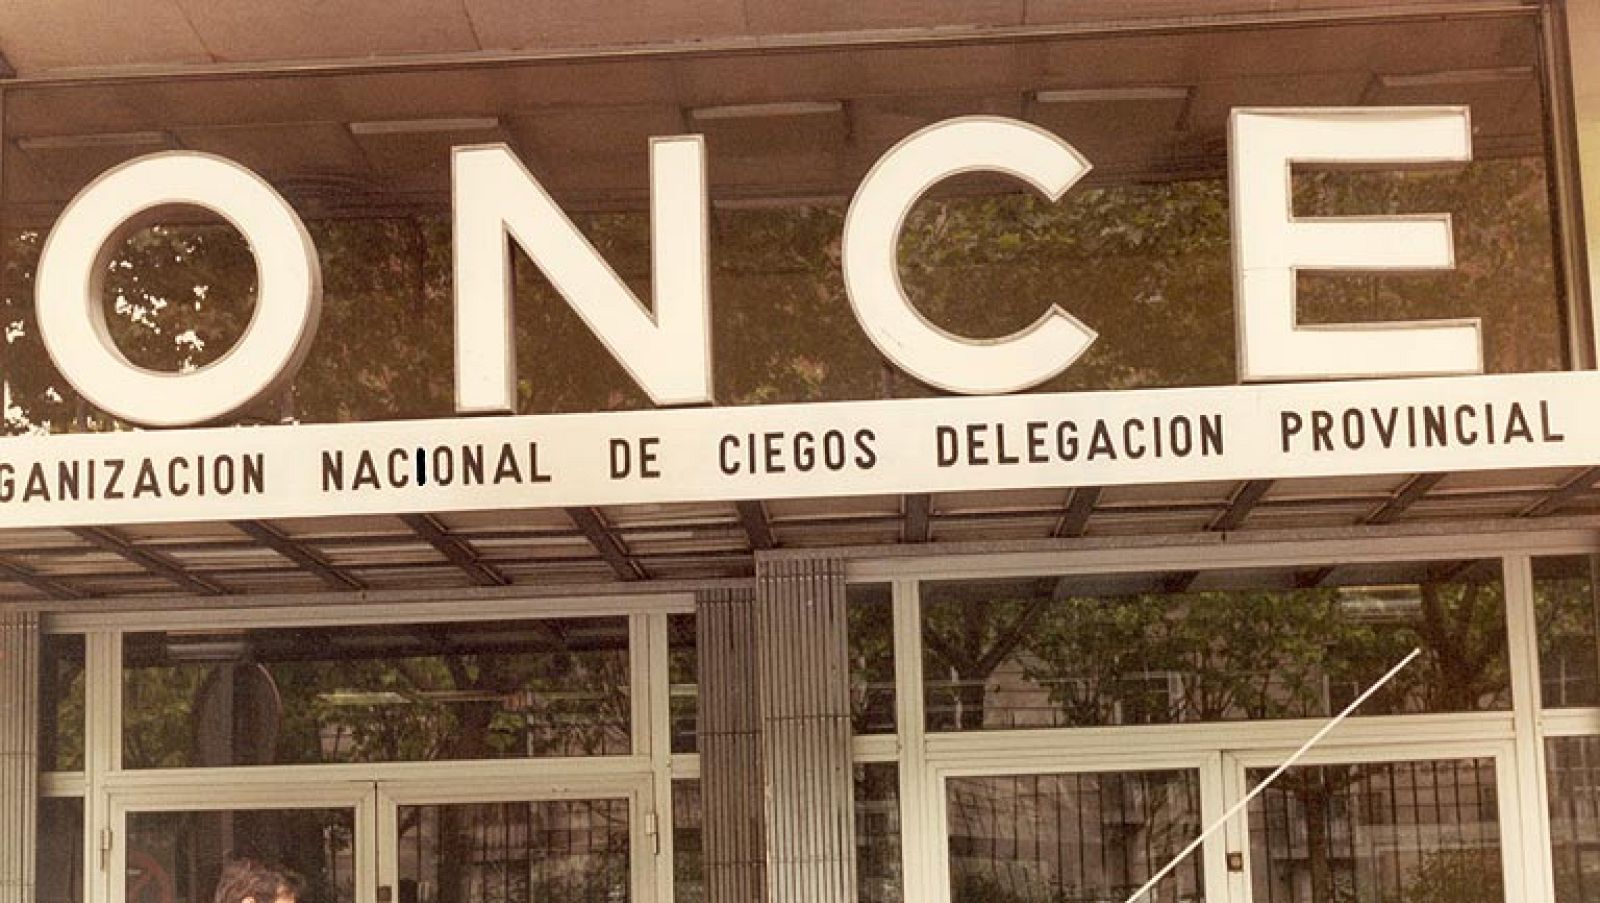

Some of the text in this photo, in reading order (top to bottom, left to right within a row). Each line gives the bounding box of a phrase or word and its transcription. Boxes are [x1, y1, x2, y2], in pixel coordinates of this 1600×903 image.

[35, 104, 1483, 426] ONCE
[322, 441, 553, 492] NACIONAL
[610, 437, 661, 479] DE
[719, 428, 876, 476] CIEGOS
[936, 414, 1224, 467] DELEGACION
[1280, 400, 1565, 453] PROVINCIAL
